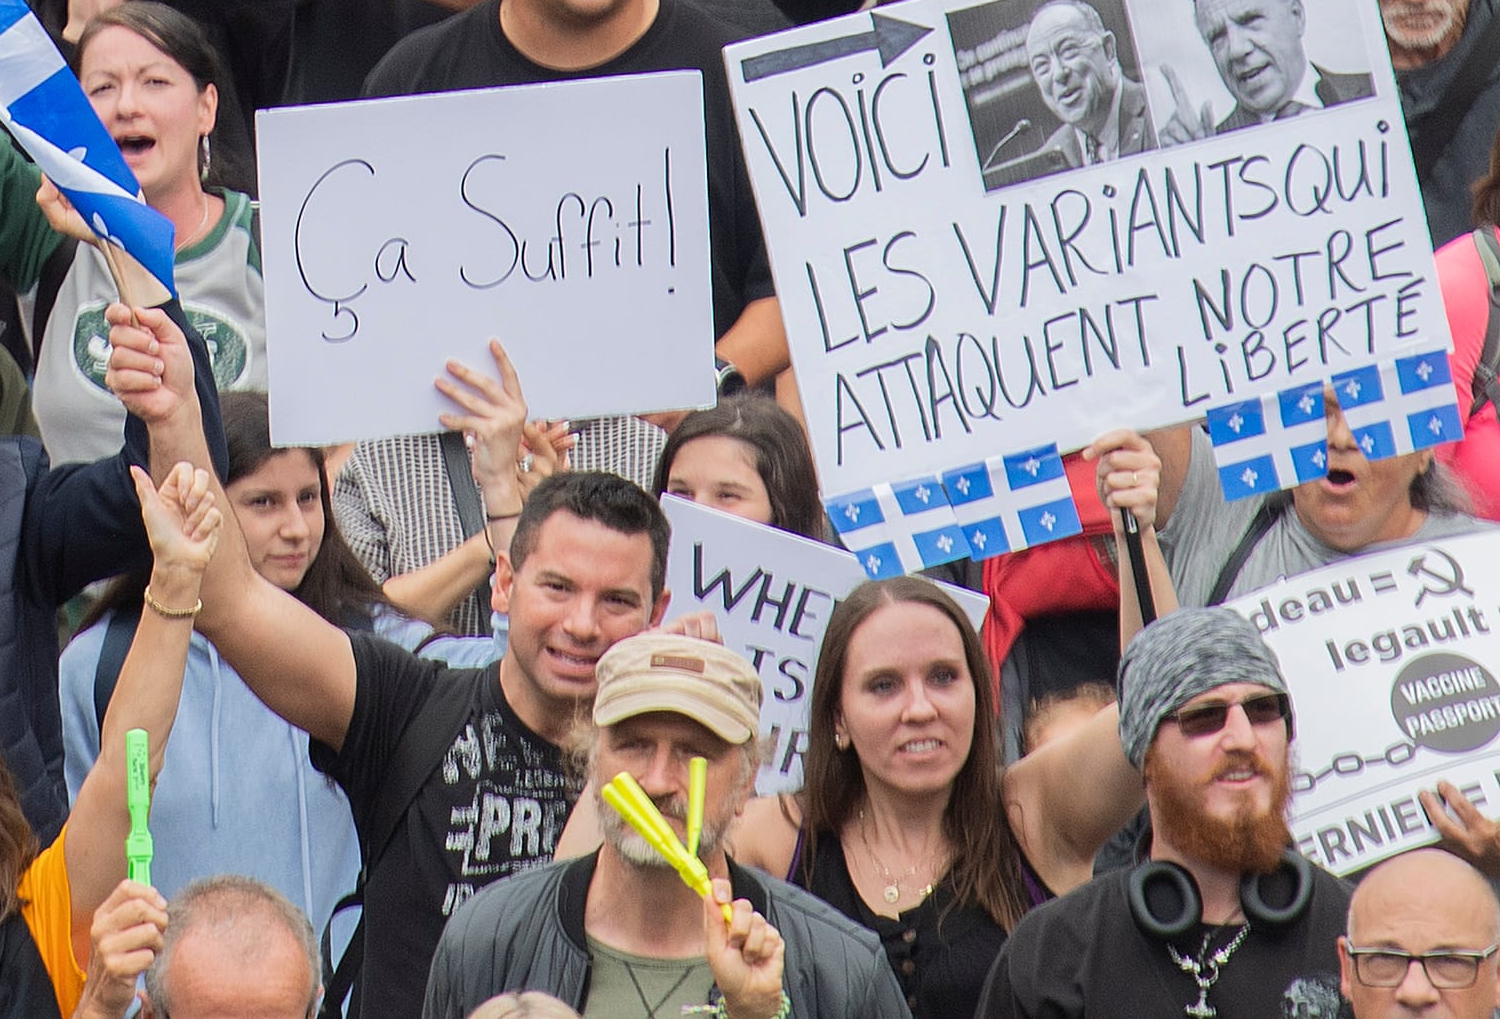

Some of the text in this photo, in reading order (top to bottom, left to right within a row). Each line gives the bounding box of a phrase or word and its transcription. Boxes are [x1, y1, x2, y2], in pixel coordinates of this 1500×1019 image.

[295, 146, 676, 343] Ça Suffit!
[805, 231, 936, 353] LES
[837, 218, 1413, 466] ATTAQUENT NOTRE
[693, 540, 834, 640] WHE
[1250, 577, 1363, 633] deau
[1325, 605, 1491, 673] legault
[1401, 668, 1487, 705] VACCINE
